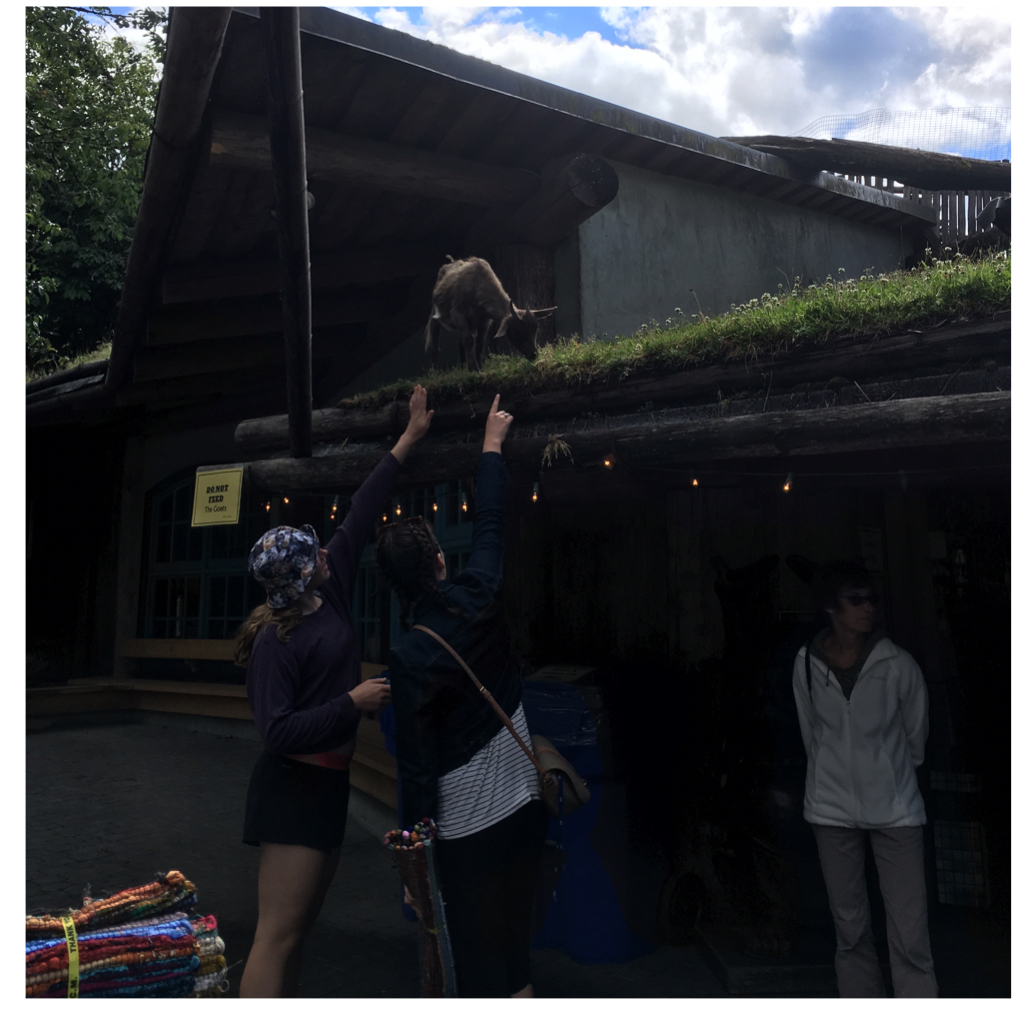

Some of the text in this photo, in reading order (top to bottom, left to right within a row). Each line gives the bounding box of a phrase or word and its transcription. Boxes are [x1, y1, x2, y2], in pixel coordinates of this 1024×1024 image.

[206, 486, 215, 494] DO
[209, 495, 224, 503] FEED
[213, 505, 227, 513] Goats
[67, 925, 77, 953] THANK
